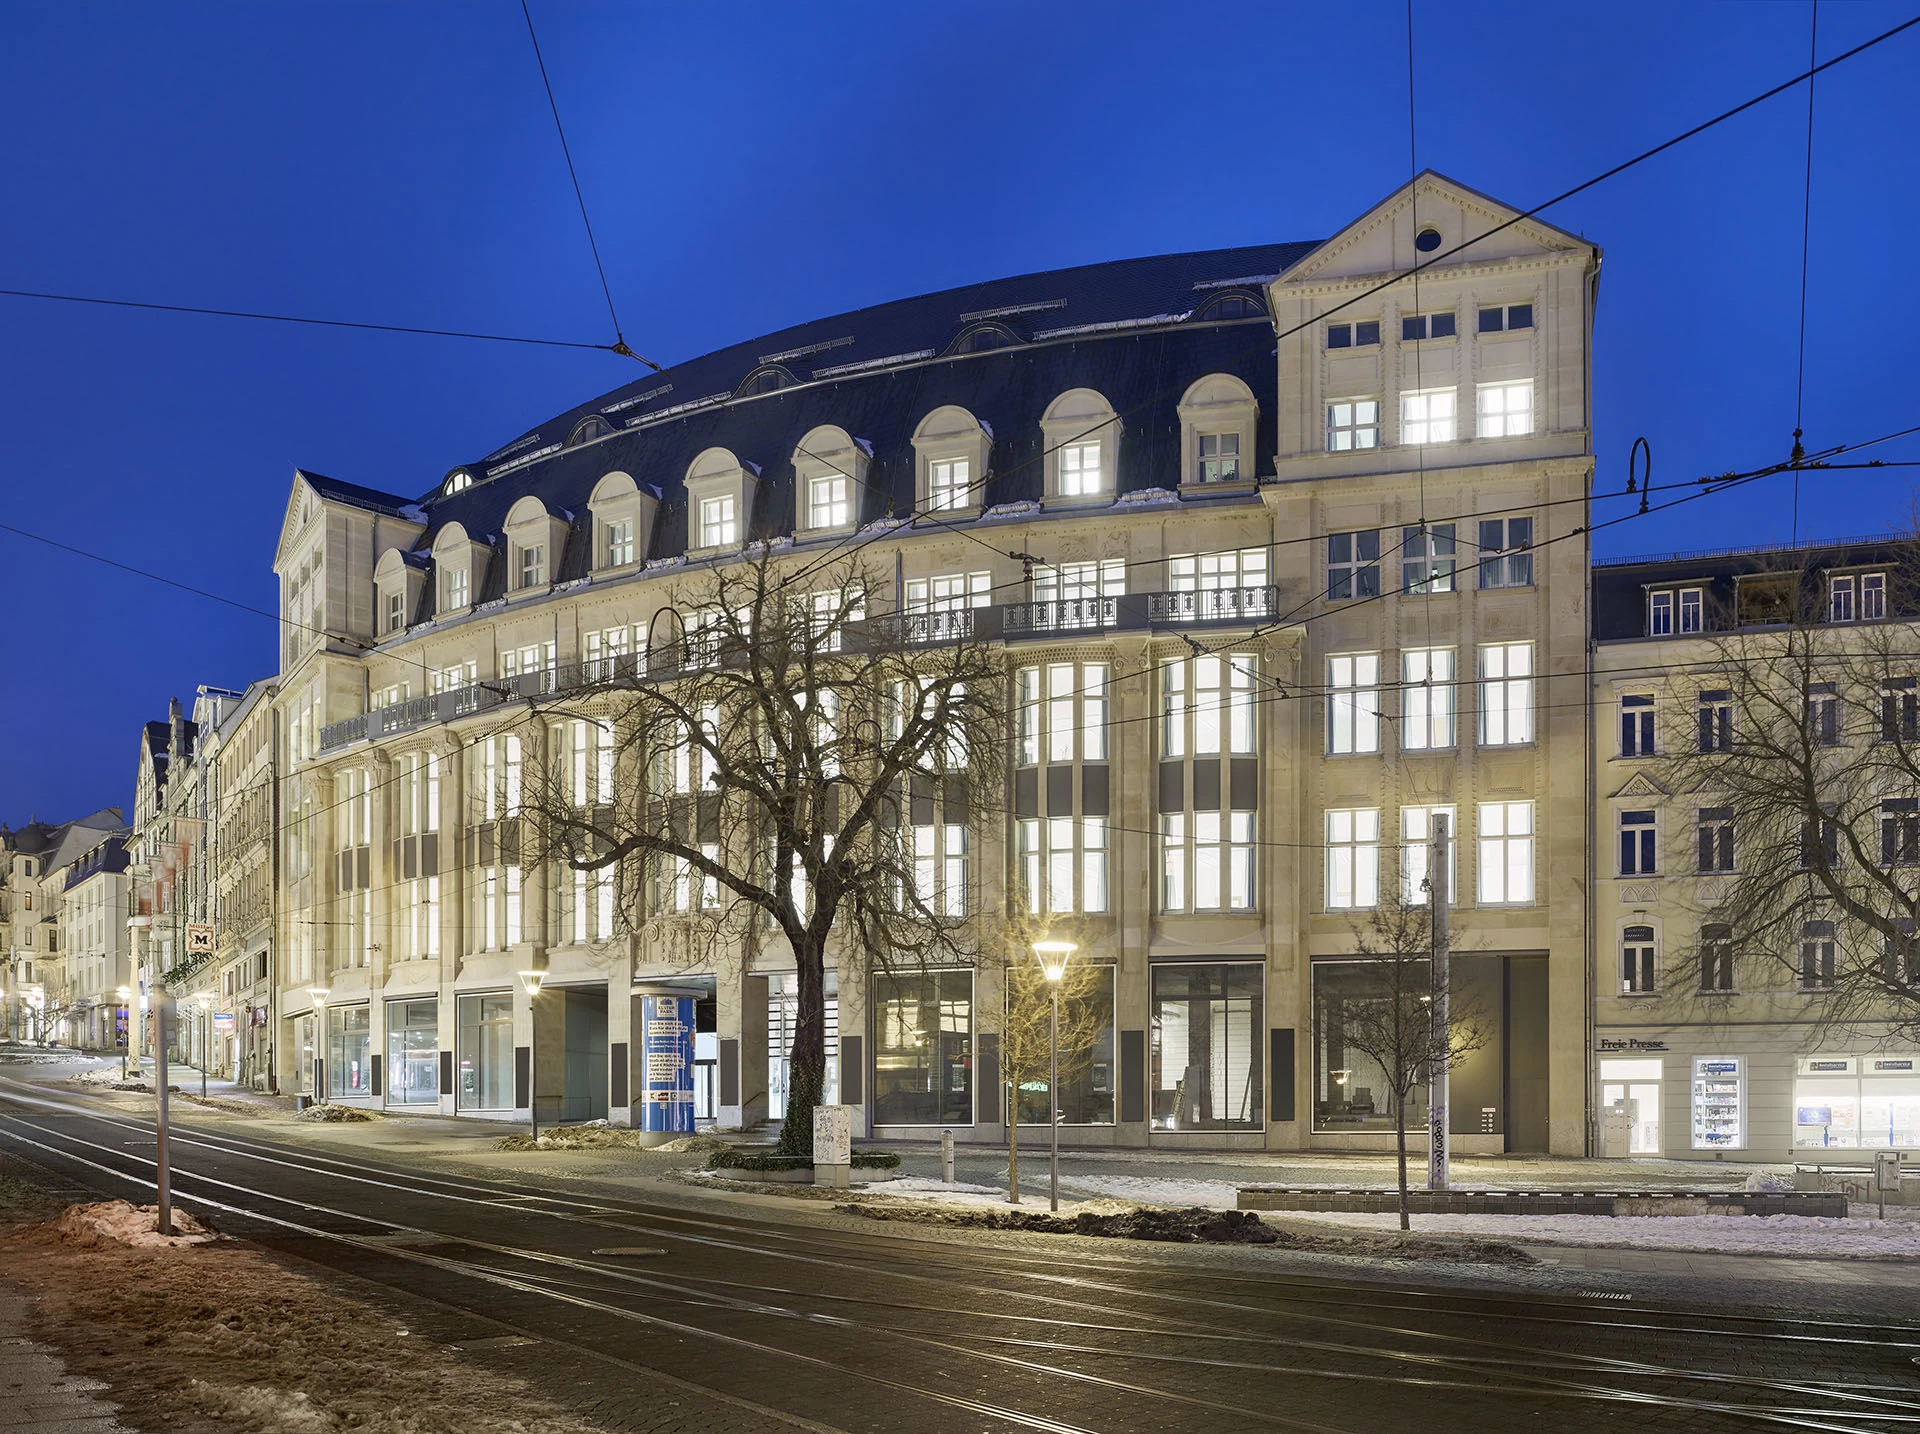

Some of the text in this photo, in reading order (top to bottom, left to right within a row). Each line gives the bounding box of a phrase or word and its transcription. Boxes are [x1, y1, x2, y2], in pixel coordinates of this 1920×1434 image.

[195, 935, 208, 944] M
[1601, 1038, 1664, 1048] Freie Presse
